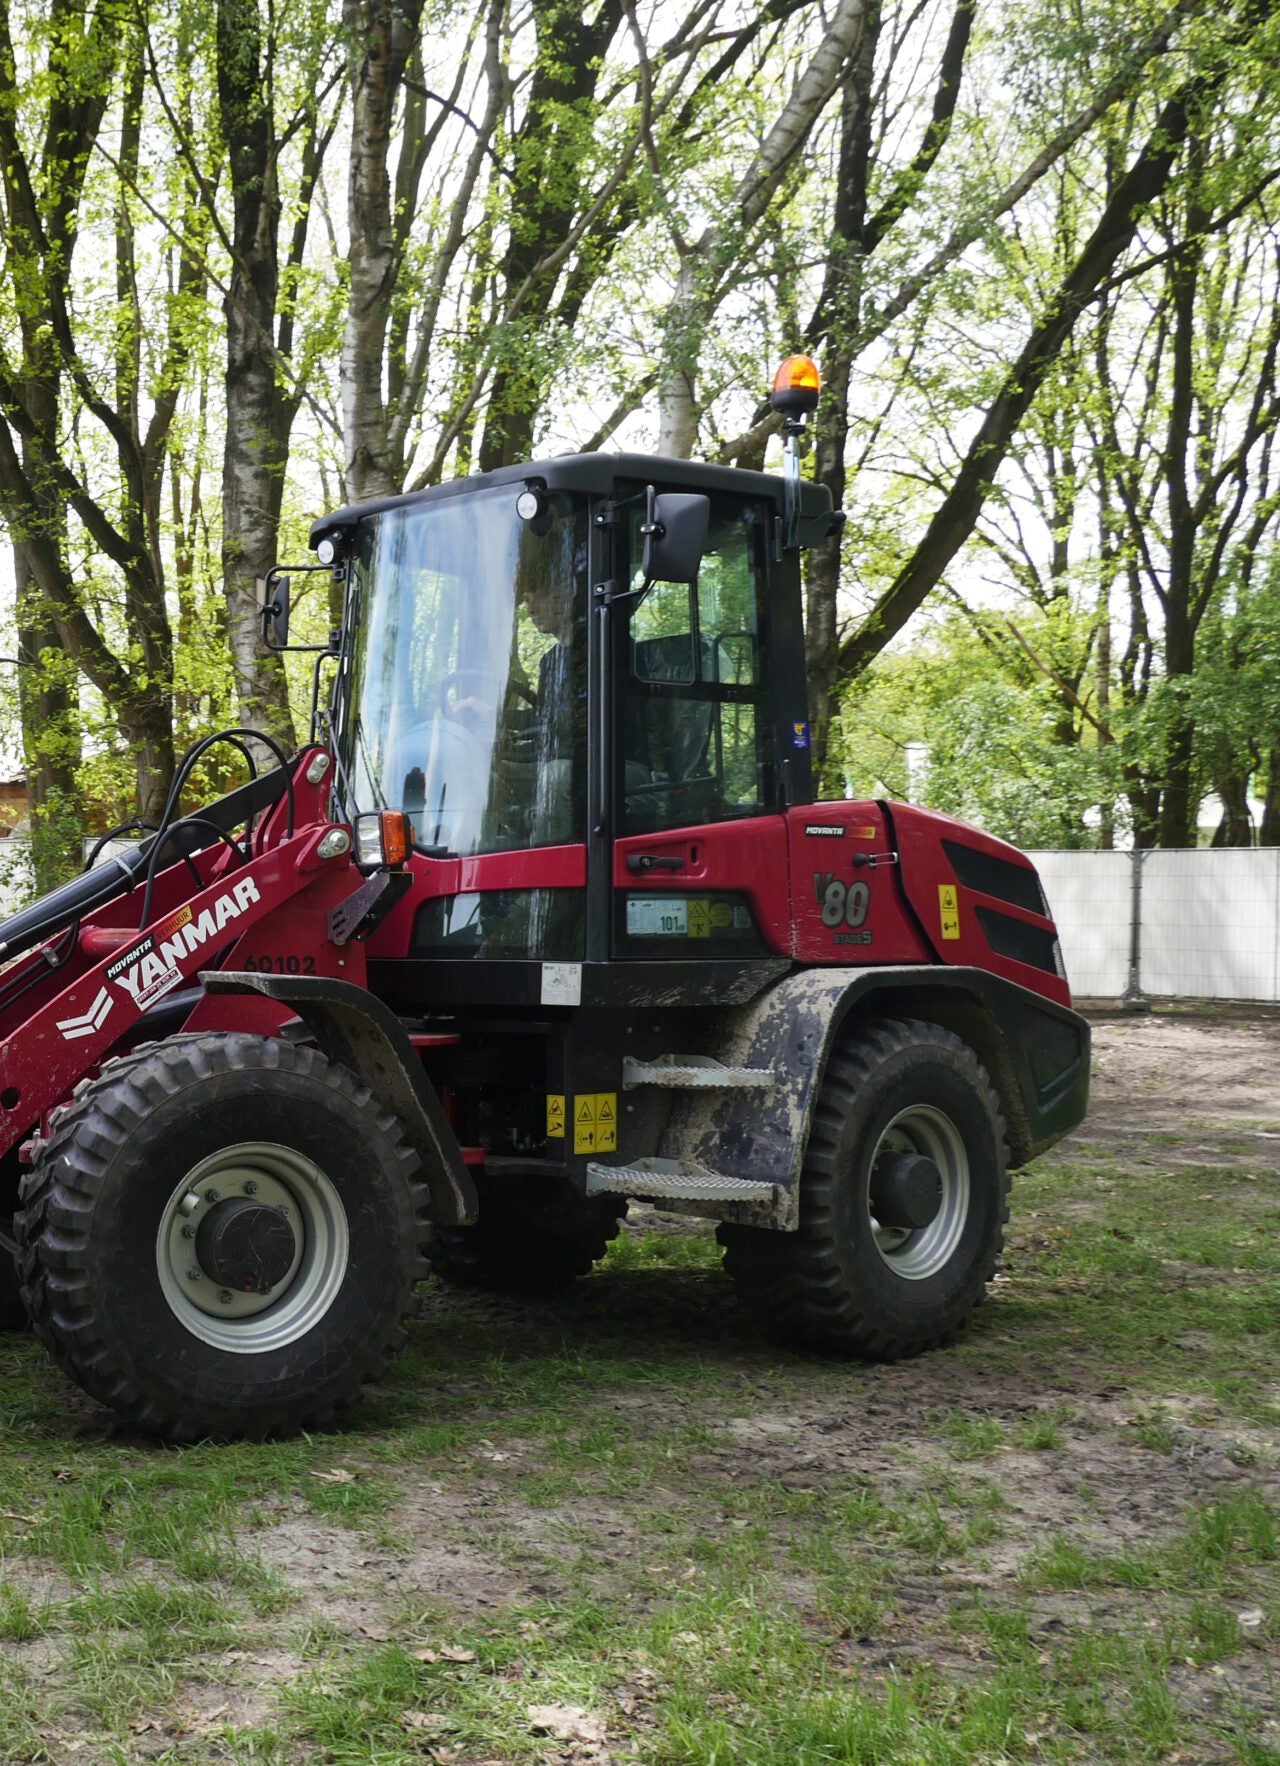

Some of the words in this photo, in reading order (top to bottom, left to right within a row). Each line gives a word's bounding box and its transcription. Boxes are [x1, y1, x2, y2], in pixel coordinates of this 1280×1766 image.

[805, 826, 844, 835] MOVANTA
[114, 876, 261, 998] YANMAR
[156, 911, 190, 940] VERHUUR
[107, 938, 153, 979] MOVANTA
[244, 955, 317, 975] 60102
